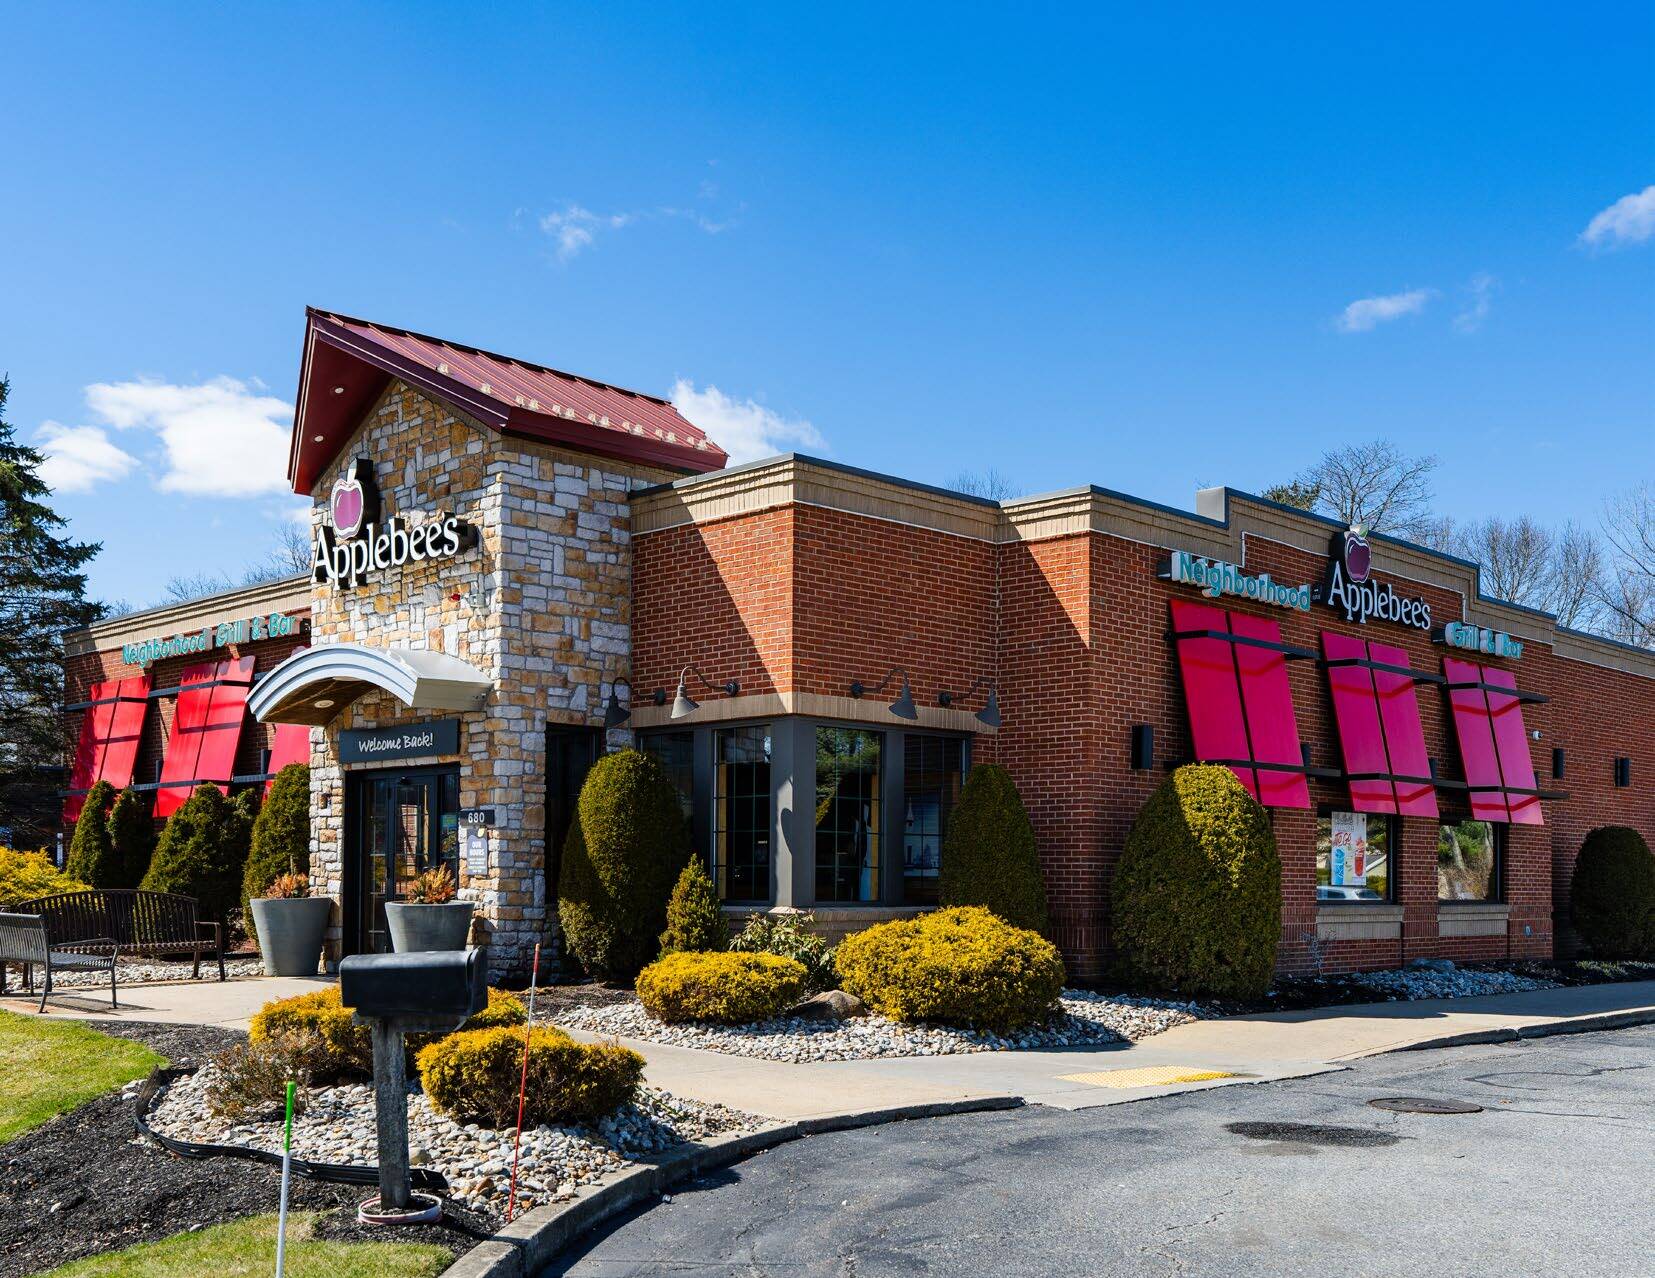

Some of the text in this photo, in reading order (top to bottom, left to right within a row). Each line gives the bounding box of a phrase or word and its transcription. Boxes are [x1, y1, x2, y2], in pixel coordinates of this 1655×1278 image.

[1174, 551, 1312, 612] Neighborhood
[1327, 560, 1431, 630] Applebee's
[122, 612, 296, 669] Neighborhood Grill & Bar
[1447, 621, 1524, 659] Grill & Bar
[402, 731, 433, 748] Back!
[467, 812, 485, 823] 680
